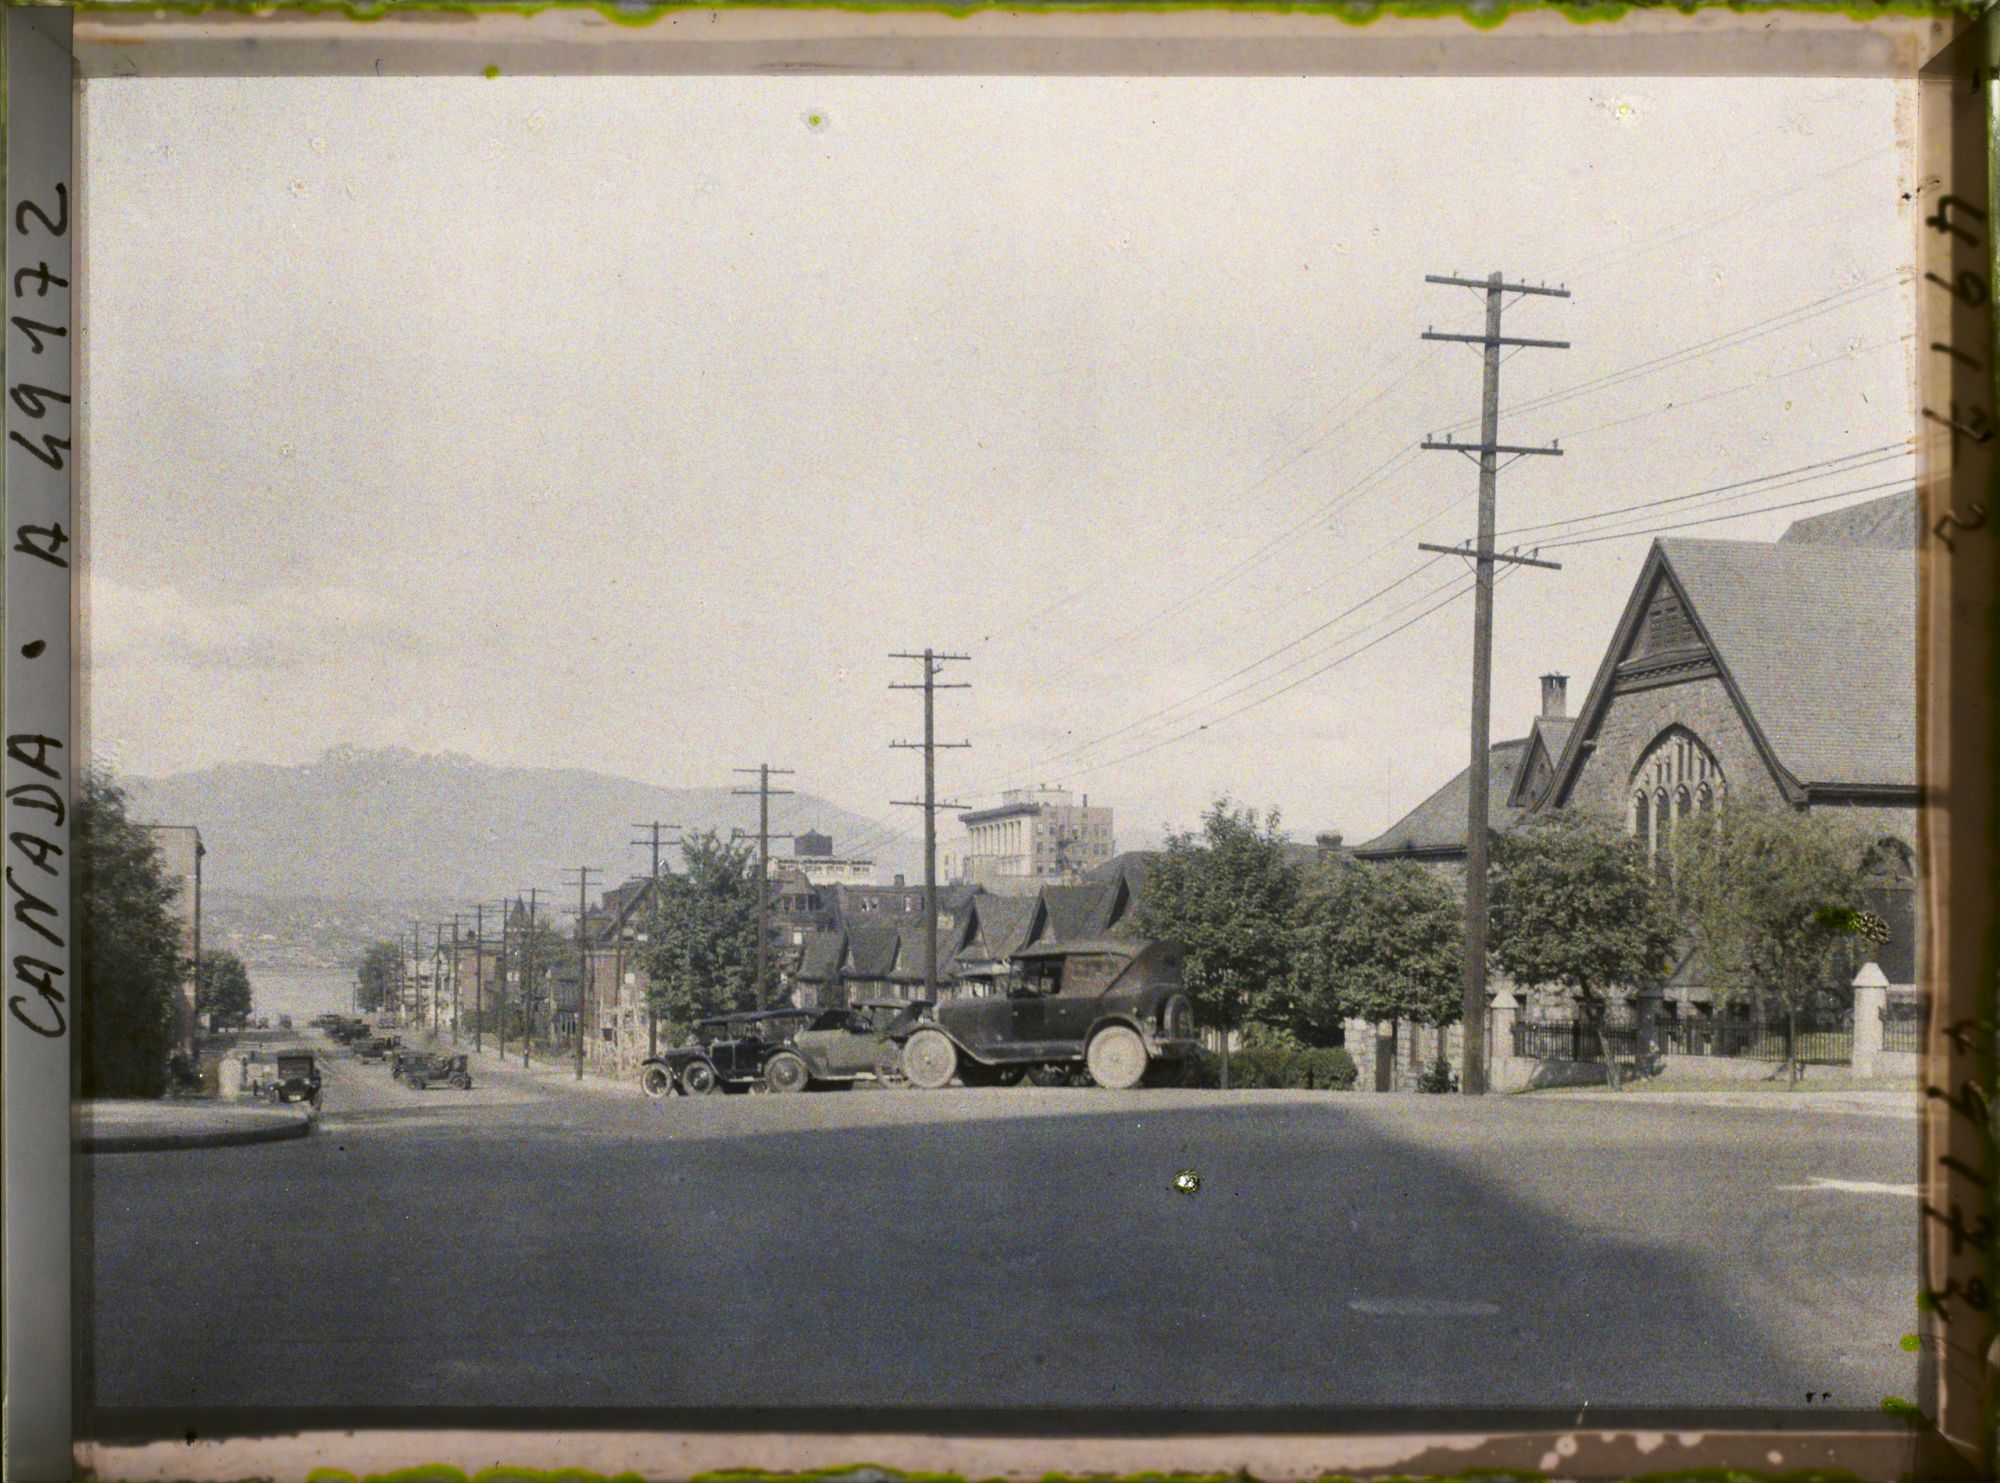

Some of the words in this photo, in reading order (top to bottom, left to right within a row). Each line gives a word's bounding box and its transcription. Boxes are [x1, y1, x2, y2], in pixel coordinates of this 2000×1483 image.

[10, 181, 71, 471] 49172
[1922, 194, 1994, 552] 49172
[14, 523, 70, 569] A
[7, 734, 66, 1038] CANADA
